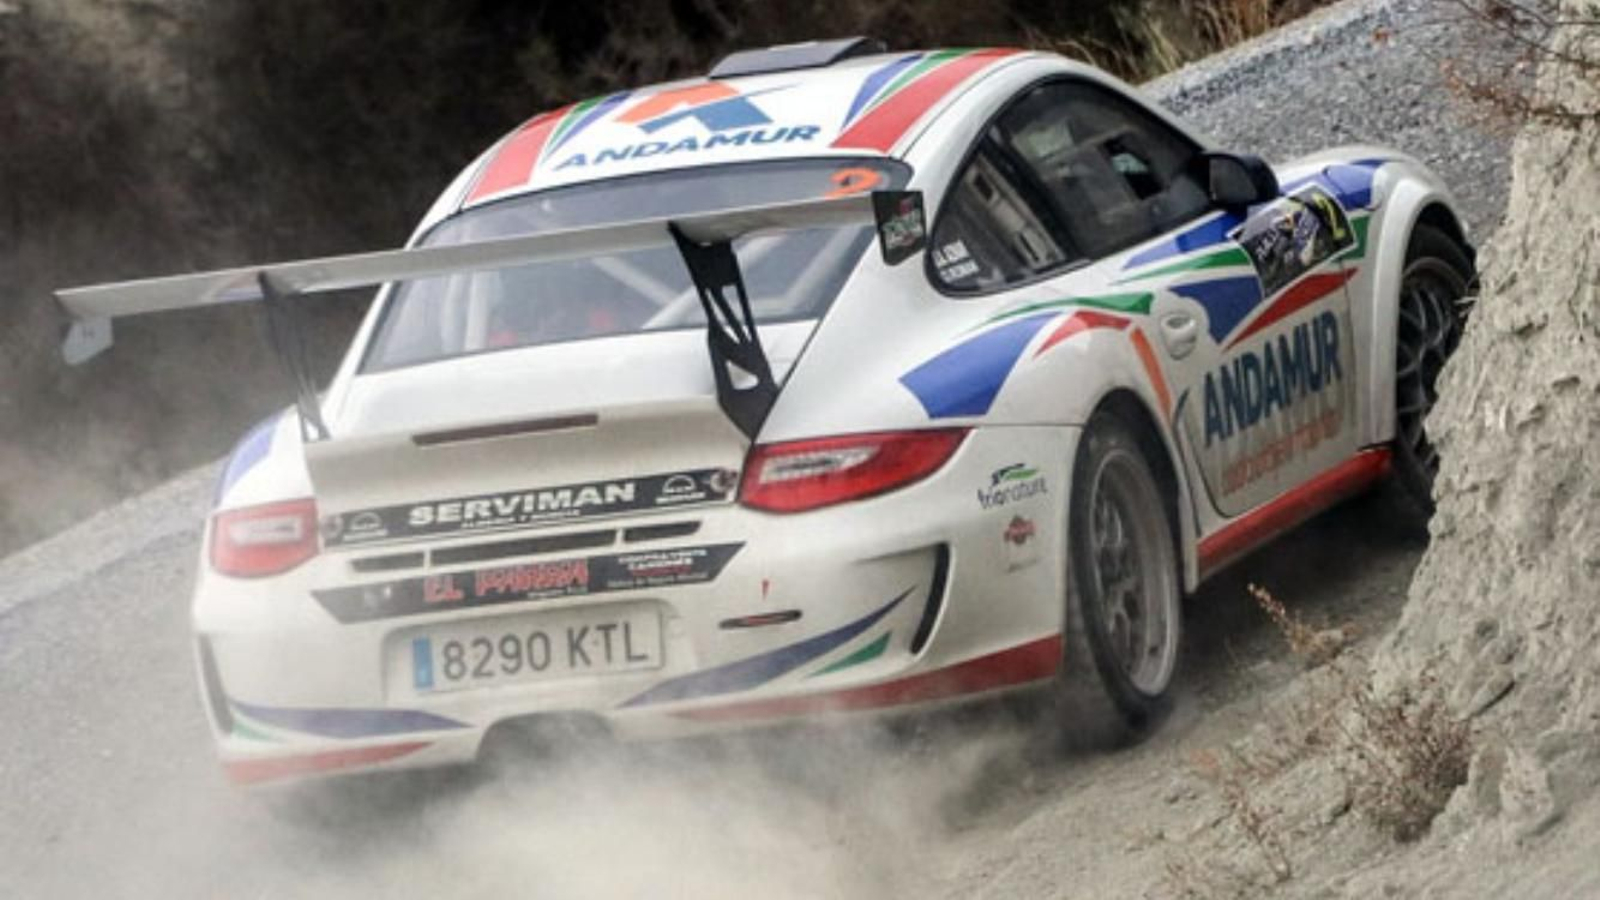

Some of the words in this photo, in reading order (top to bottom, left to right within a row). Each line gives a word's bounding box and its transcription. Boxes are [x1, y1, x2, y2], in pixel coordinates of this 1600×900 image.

[553, 125, 821, 172] ANDAMUR
[1203, 310, 1343, 449] ANDAMUR
[408, 482, 636, 527] SERVIMAN
[442, 629, 552, 681] 8290
[566, 620, 649, 669] KTL
